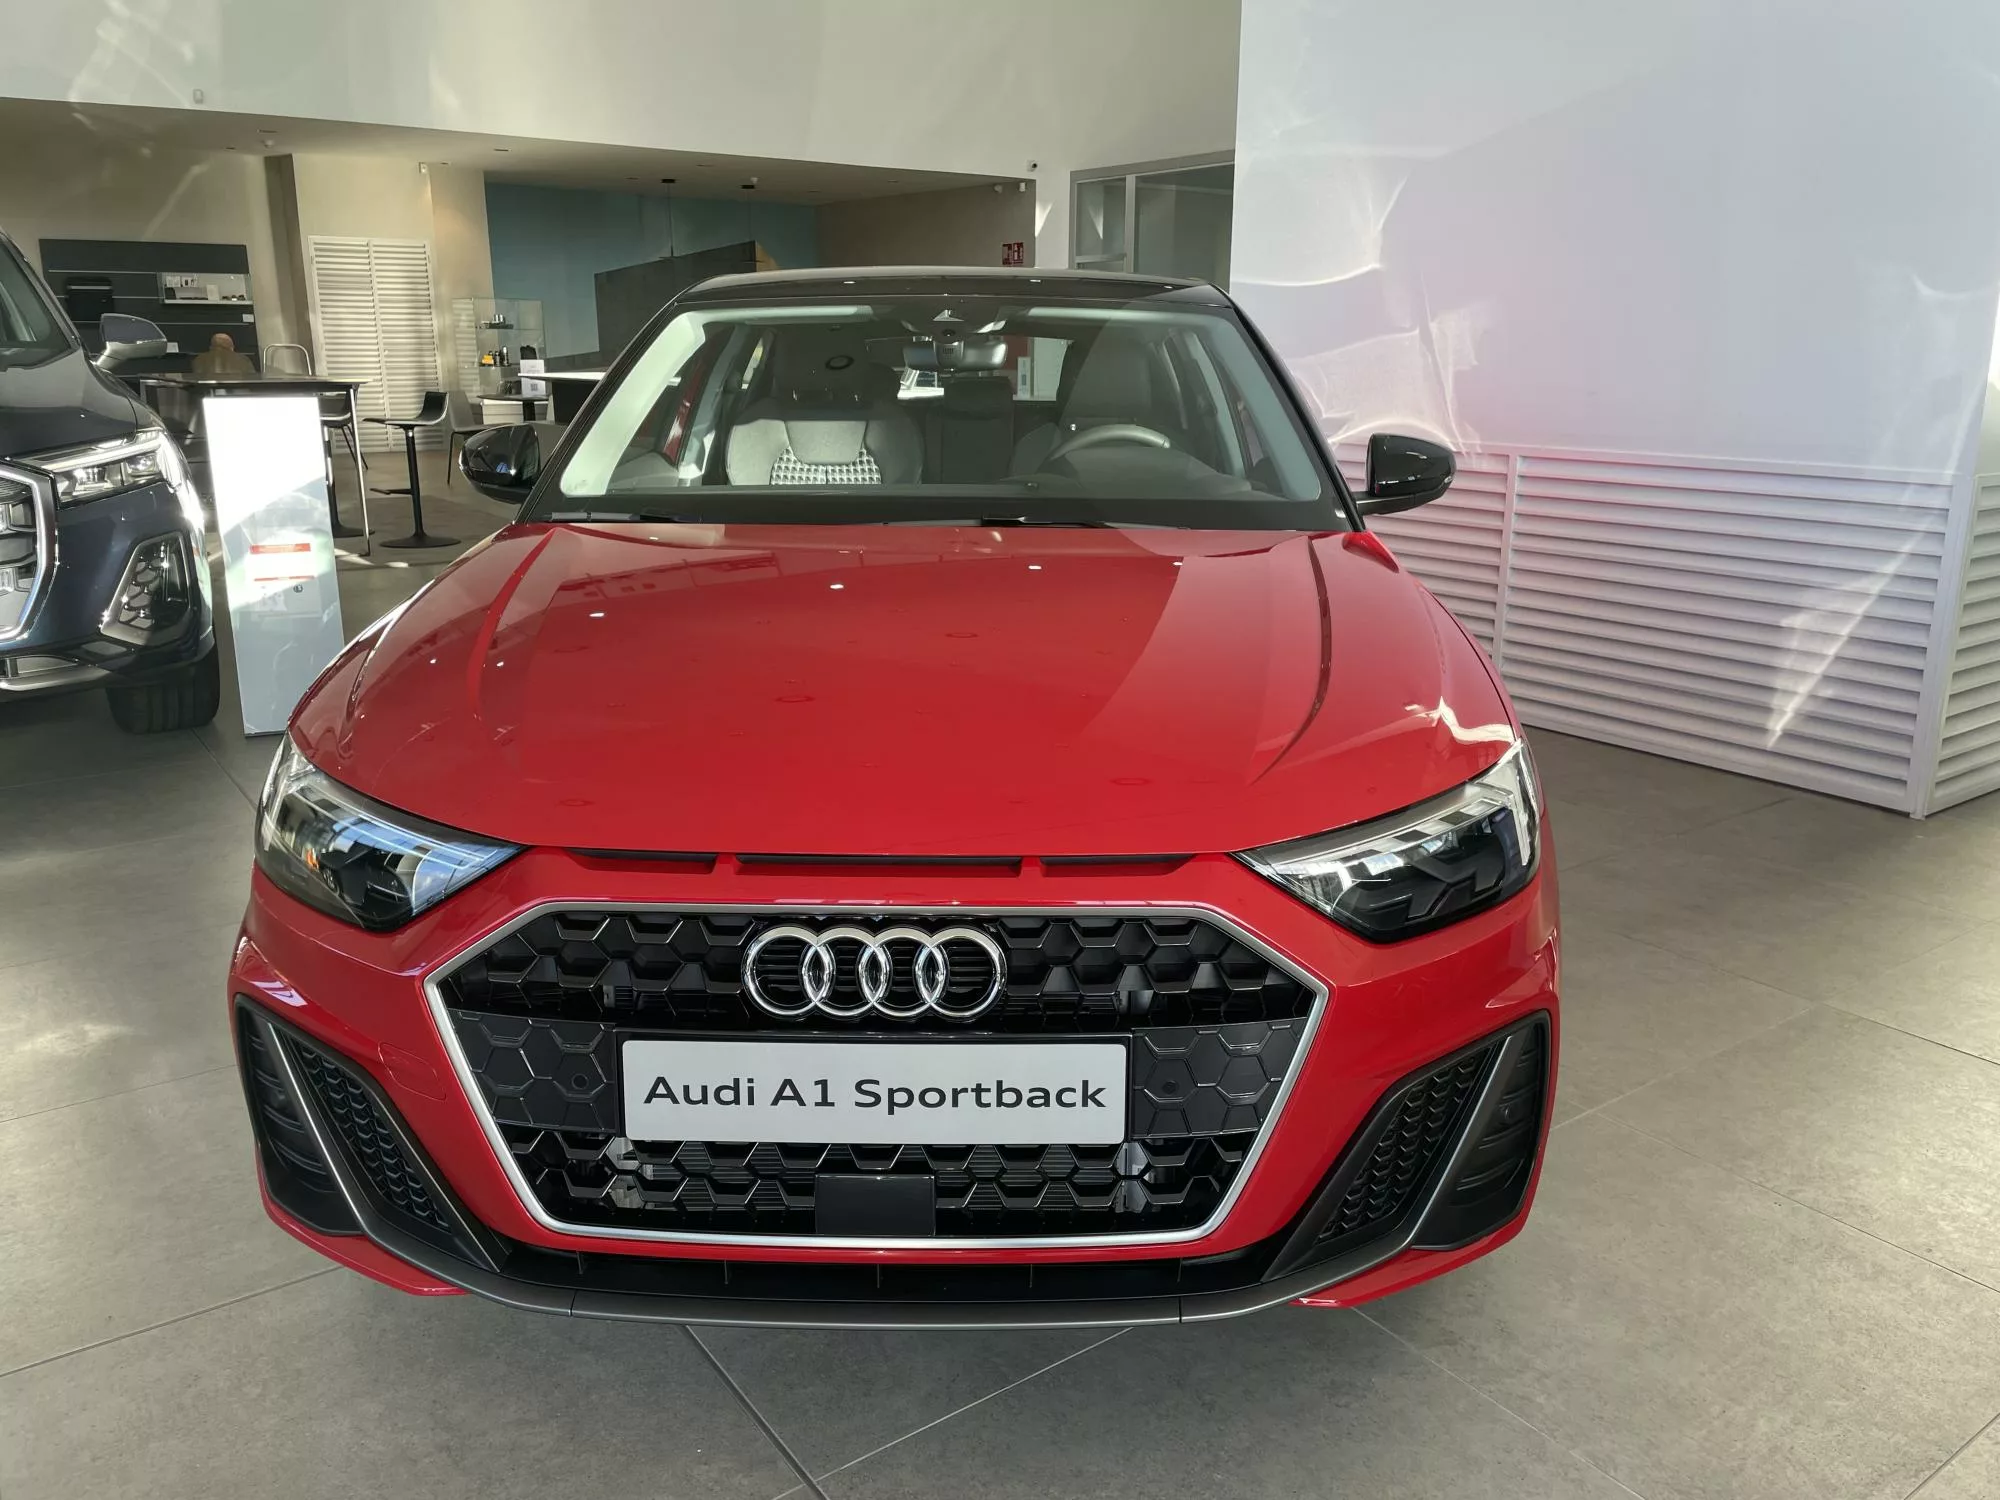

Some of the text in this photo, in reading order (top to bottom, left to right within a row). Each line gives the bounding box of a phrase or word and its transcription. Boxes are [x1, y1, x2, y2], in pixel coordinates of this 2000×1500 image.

[643, 1076, 1108, 1116] Audi A1 Sportback
